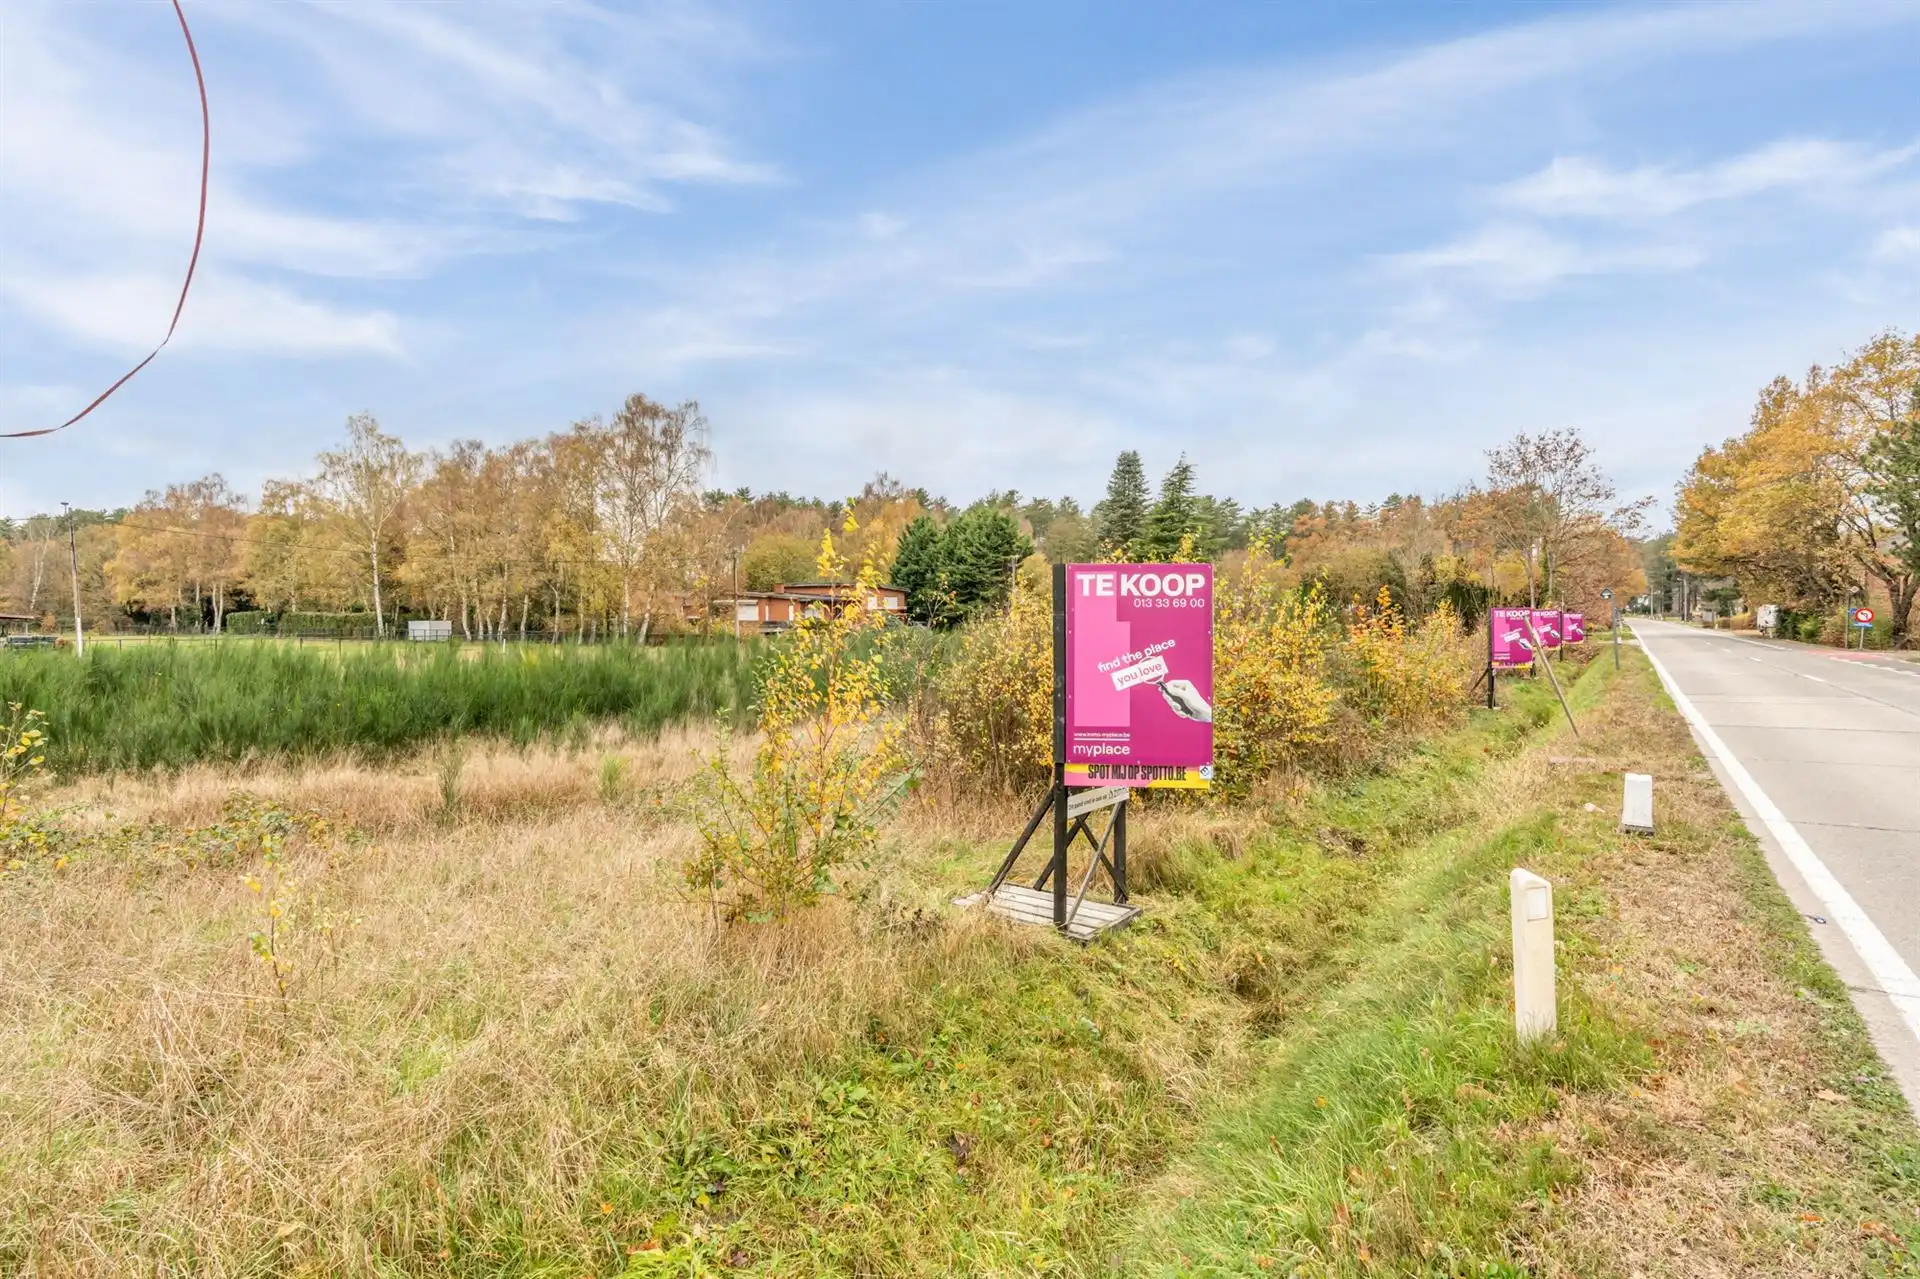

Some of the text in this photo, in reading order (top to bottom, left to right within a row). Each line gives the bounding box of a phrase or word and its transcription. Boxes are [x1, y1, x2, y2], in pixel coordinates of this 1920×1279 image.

[1076, 574, 1205, 596] TE KOOP
[1134, 598, 1205, 608] 013 33 69 00
[1097, 639, 1176, 672] find the place
[1117, 663, 1162, 686] you love
[1073, 742, 1131, 757] myplace
[1088, 764, 1110, 779] SPOT
[1111, 765, 1126, 780] MIJ
[1128, 765, 1140, 780] OP
[1141, 766, 1187, 781] SPOTTO.BE
